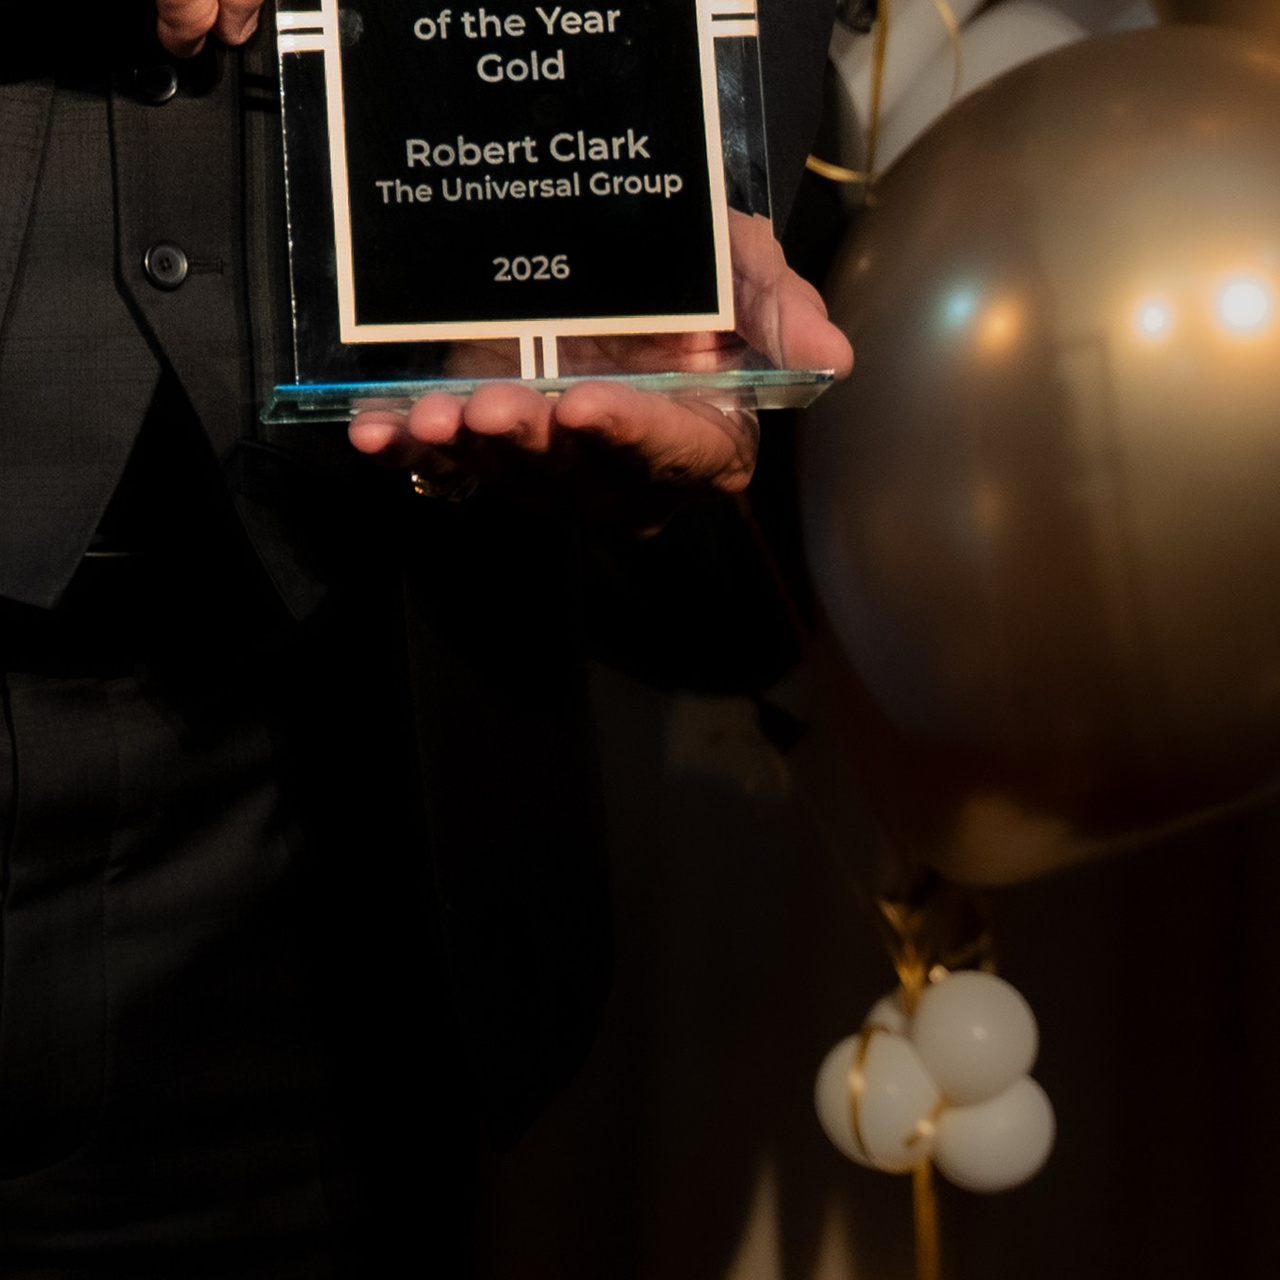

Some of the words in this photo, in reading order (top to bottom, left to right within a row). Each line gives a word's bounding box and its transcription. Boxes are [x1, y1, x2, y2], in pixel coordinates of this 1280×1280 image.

[413, 9, 452, 40] of
[461, 8, 526, 39] the
[535, 6, 621, 35] Year
[476, 49, 565, 83] Gold
[406, 135, 538, 167] Robert
[550, 128, 651, 162] Clark
[375, 179, 433, 203] The
[442, 172, 580, 201] Universal
[589, 171, 683, 198] Group
[493, 255, 570, 281] 2026
